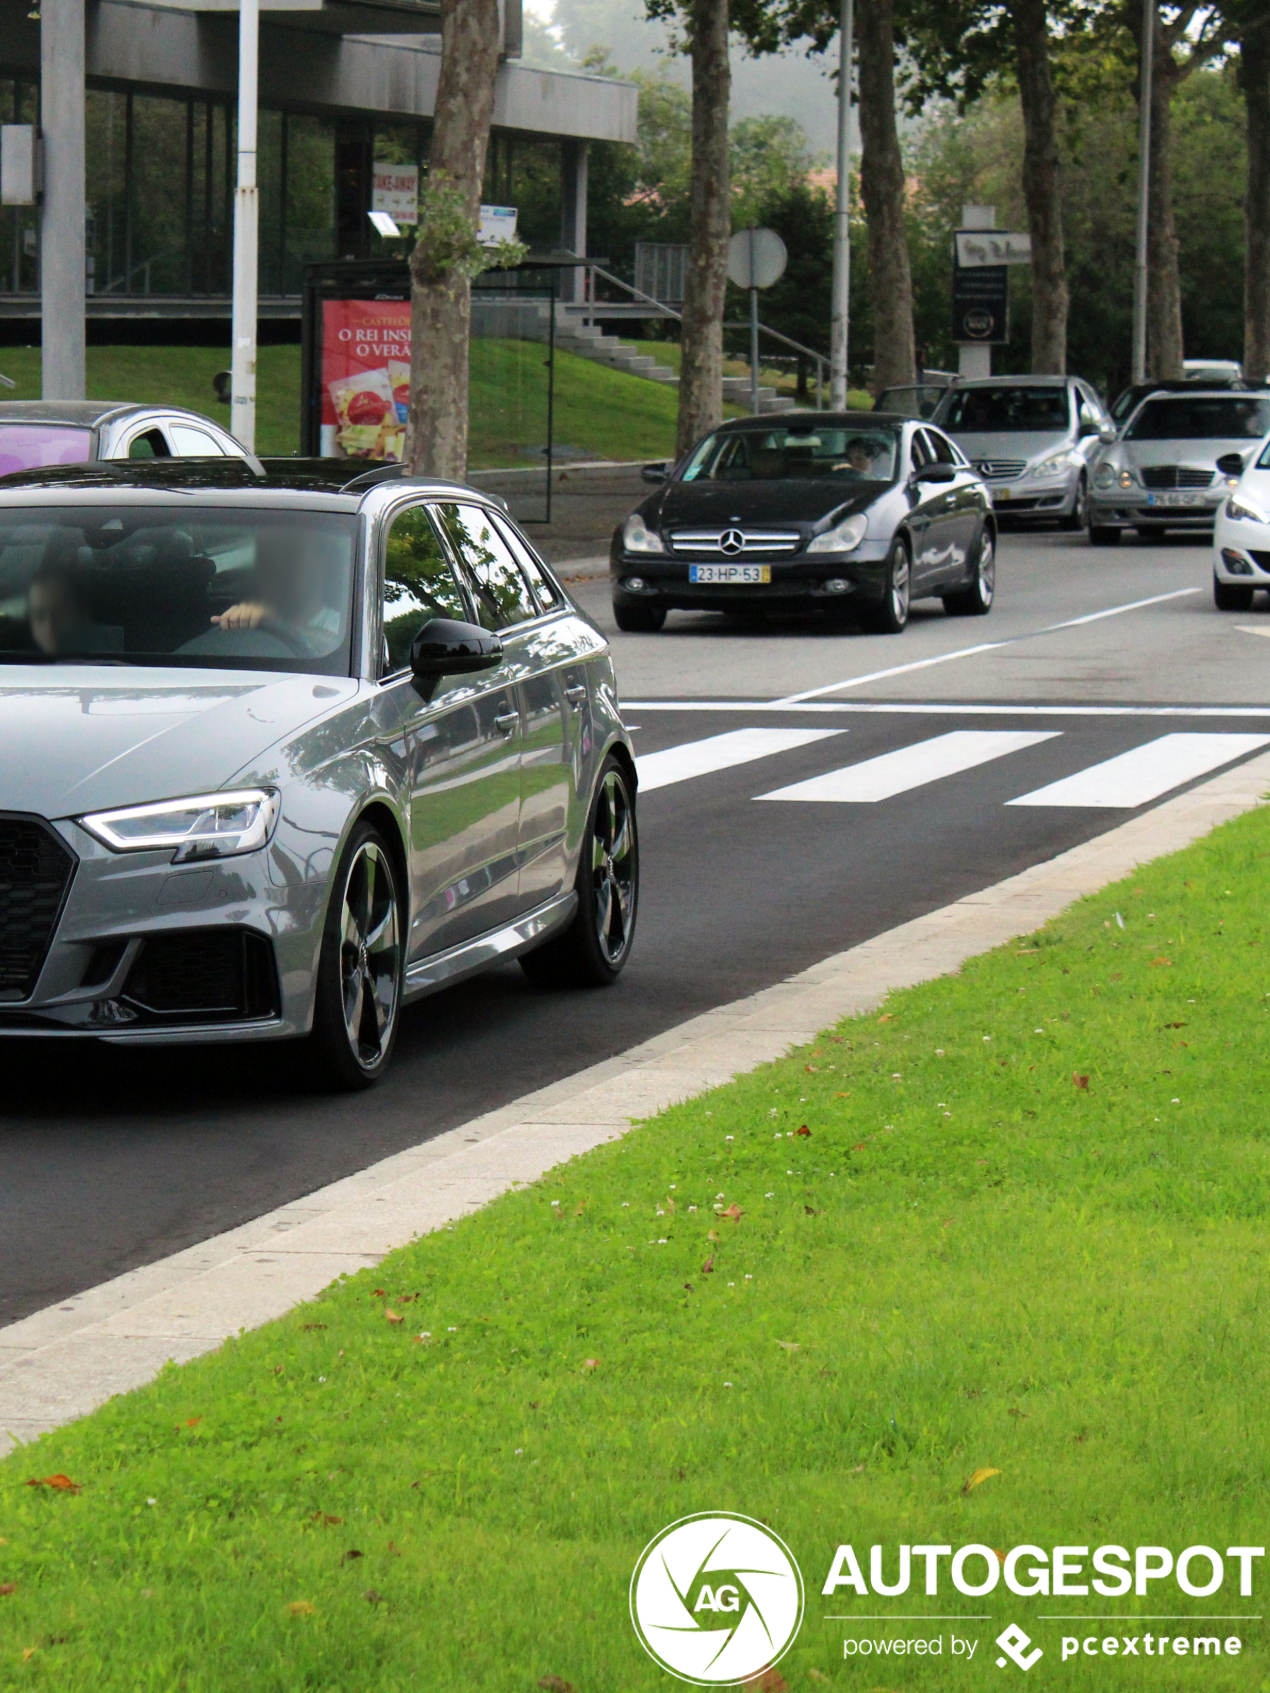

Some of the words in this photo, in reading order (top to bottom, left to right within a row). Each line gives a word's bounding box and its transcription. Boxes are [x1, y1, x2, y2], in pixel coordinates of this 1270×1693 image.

[362, 315, 411, 327] CASTELÕ
[338, 329, 351, 341] O
[356, 329, 378, 341] REI
[356, 344, 369, 357] O
[372, 341, 411, 357] VERÃ
